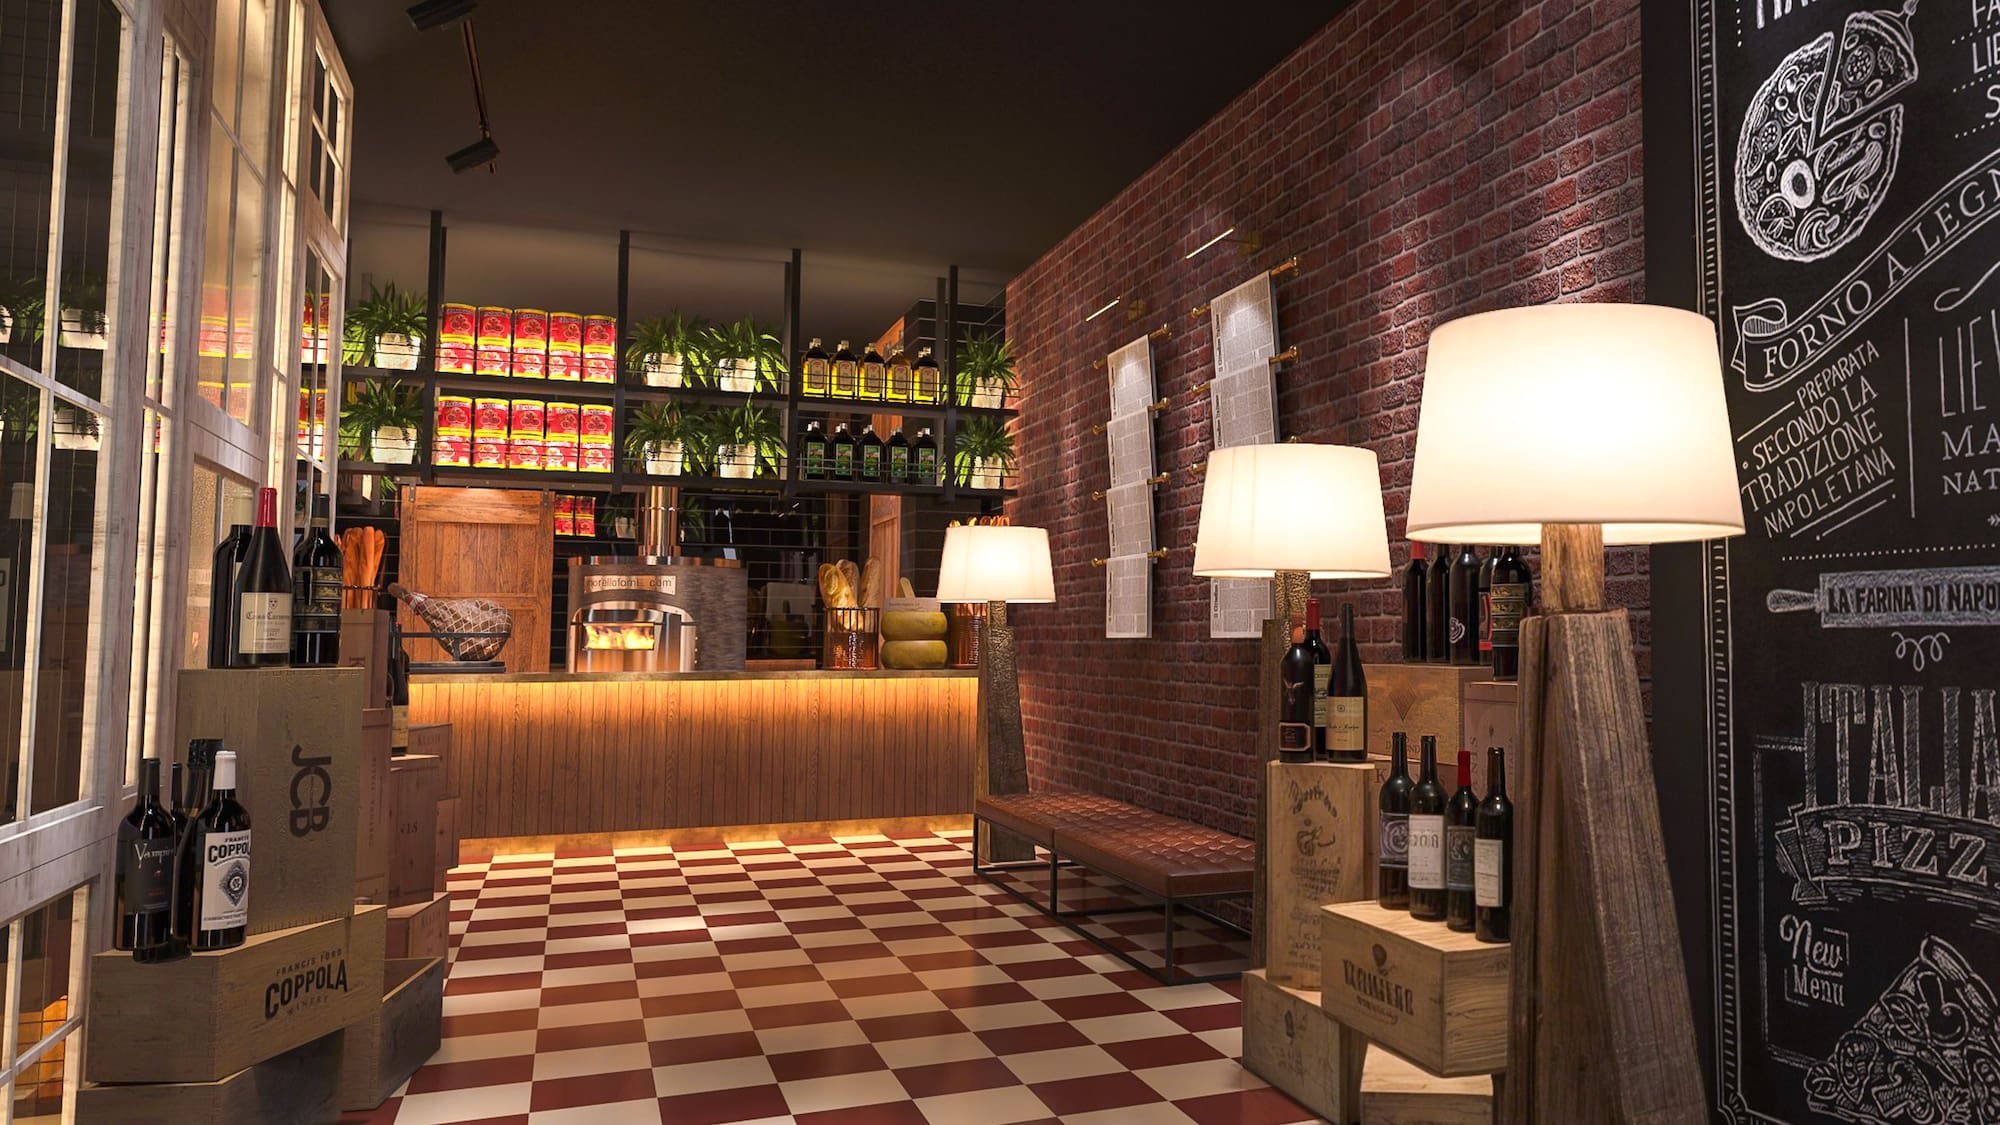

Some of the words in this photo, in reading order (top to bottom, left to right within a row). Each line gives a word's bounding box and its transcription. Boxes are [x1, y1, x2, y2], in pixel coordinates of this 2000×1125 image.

[1763, 280, 1872, 378] FORNO
[1886, 252, 1912, 289] A
[1797, 340, 1880, 409] PREPARATA
[1752, 396, 1841, 470] SECONDO
[1841, 375, 1879, 412] LA
[1741, 408, 1883, 512] TRADIZIONE
[1764, 447, 1896, 538] NAPOLETANA
[1828, 586, 1850, 613] LA
[1855, 585, 1915, 613] FARINA
[1923, 583, 1941, 612] DI
[1948, 581, 2000, 613] NAPO
[289, 744, 332, 838] JCB
[1822, 820, 2000, 887] PIZZ
[276, 956, 317, 977] FRANCIS
[1779, 914, 1844, 977] New
[265, 959, 348, 1020] COPPOLA
[1793, 963, 1845, 1007] Menu
